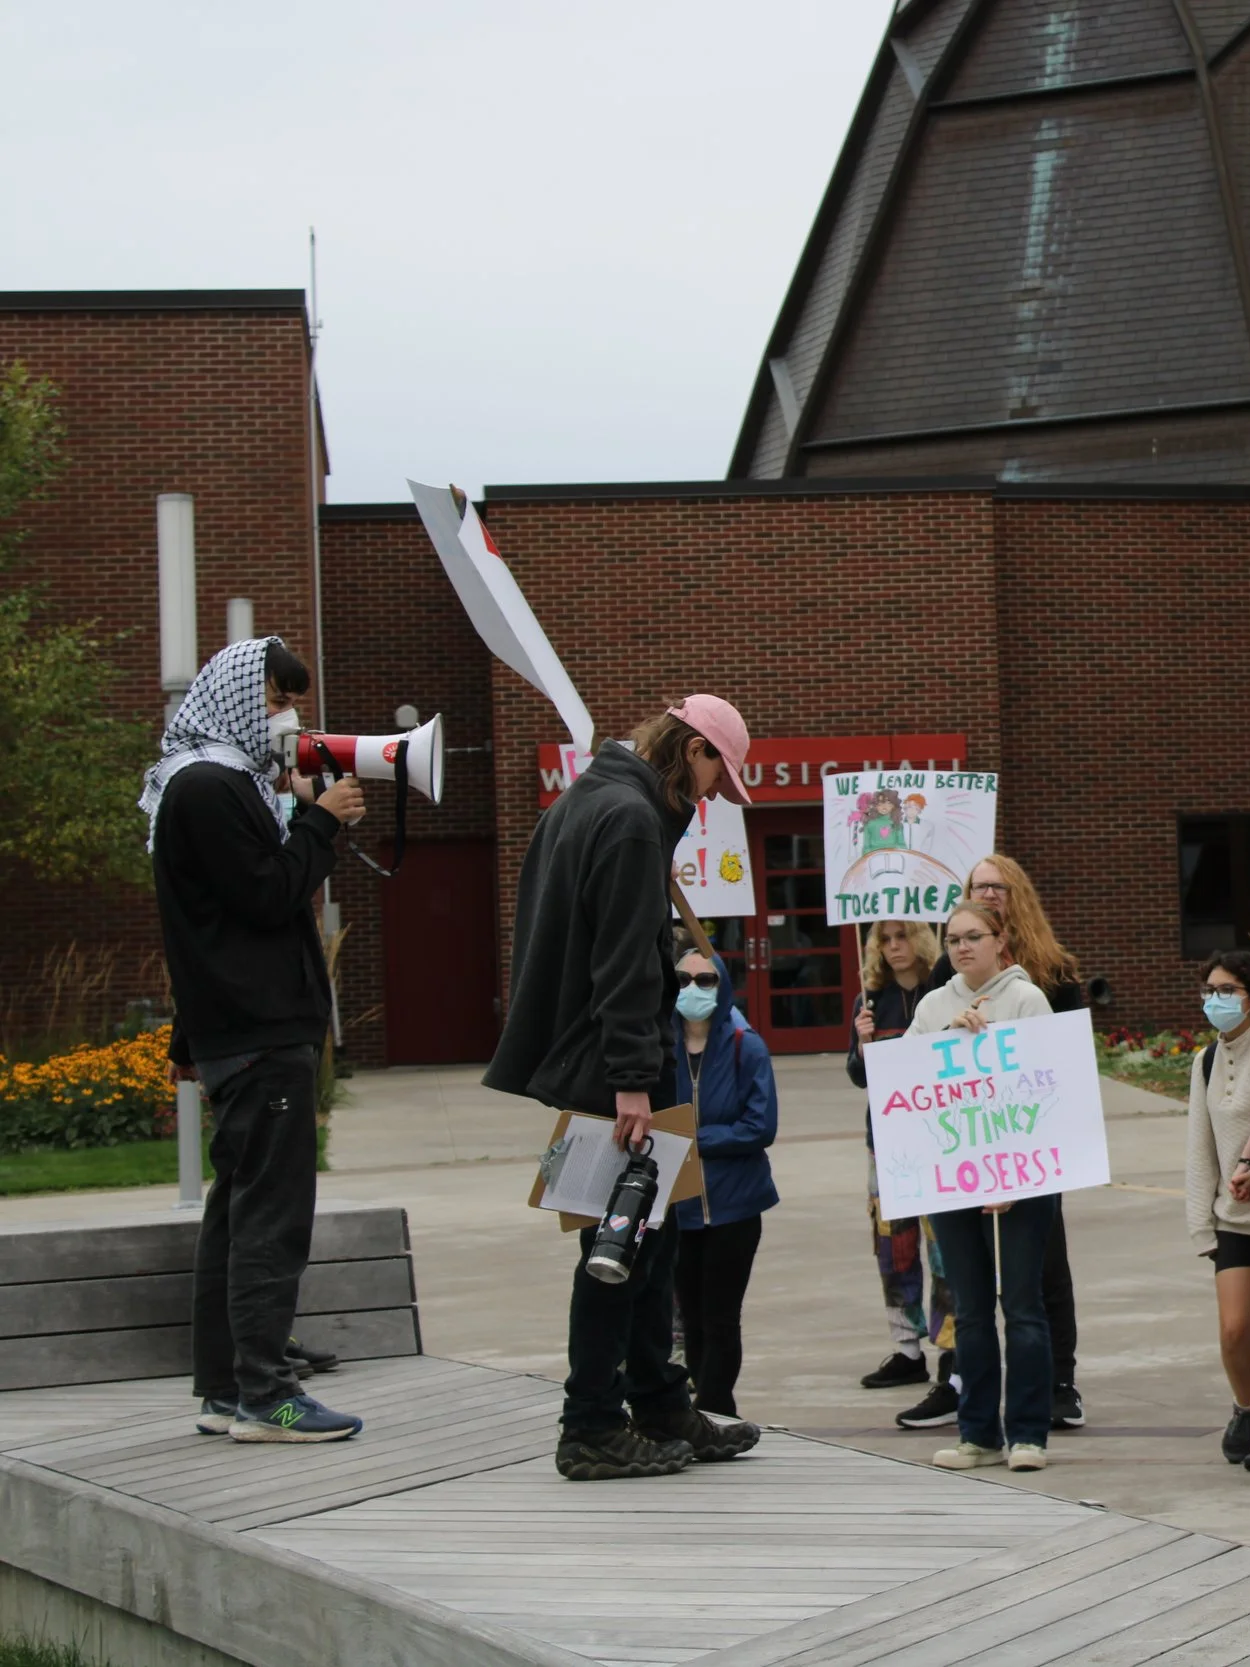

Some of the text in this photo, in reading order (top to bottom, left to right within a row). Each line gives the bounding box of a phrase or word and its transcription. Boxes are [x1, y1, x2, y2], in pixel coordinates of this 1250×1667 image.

[742, 761, 839, 787] USIC
[836, 772, 998, 796] WE LEARN BETTER
[834, 884, 963, 920] TOGETHER
[931, 1027, 1020, 1079] ICE
[881, 1068, 1058, 1116] AGENTS ARE
[937, 1102, 1041, 1155] STINKY
[933, 1147, 1063, 1193] LOSERS!
